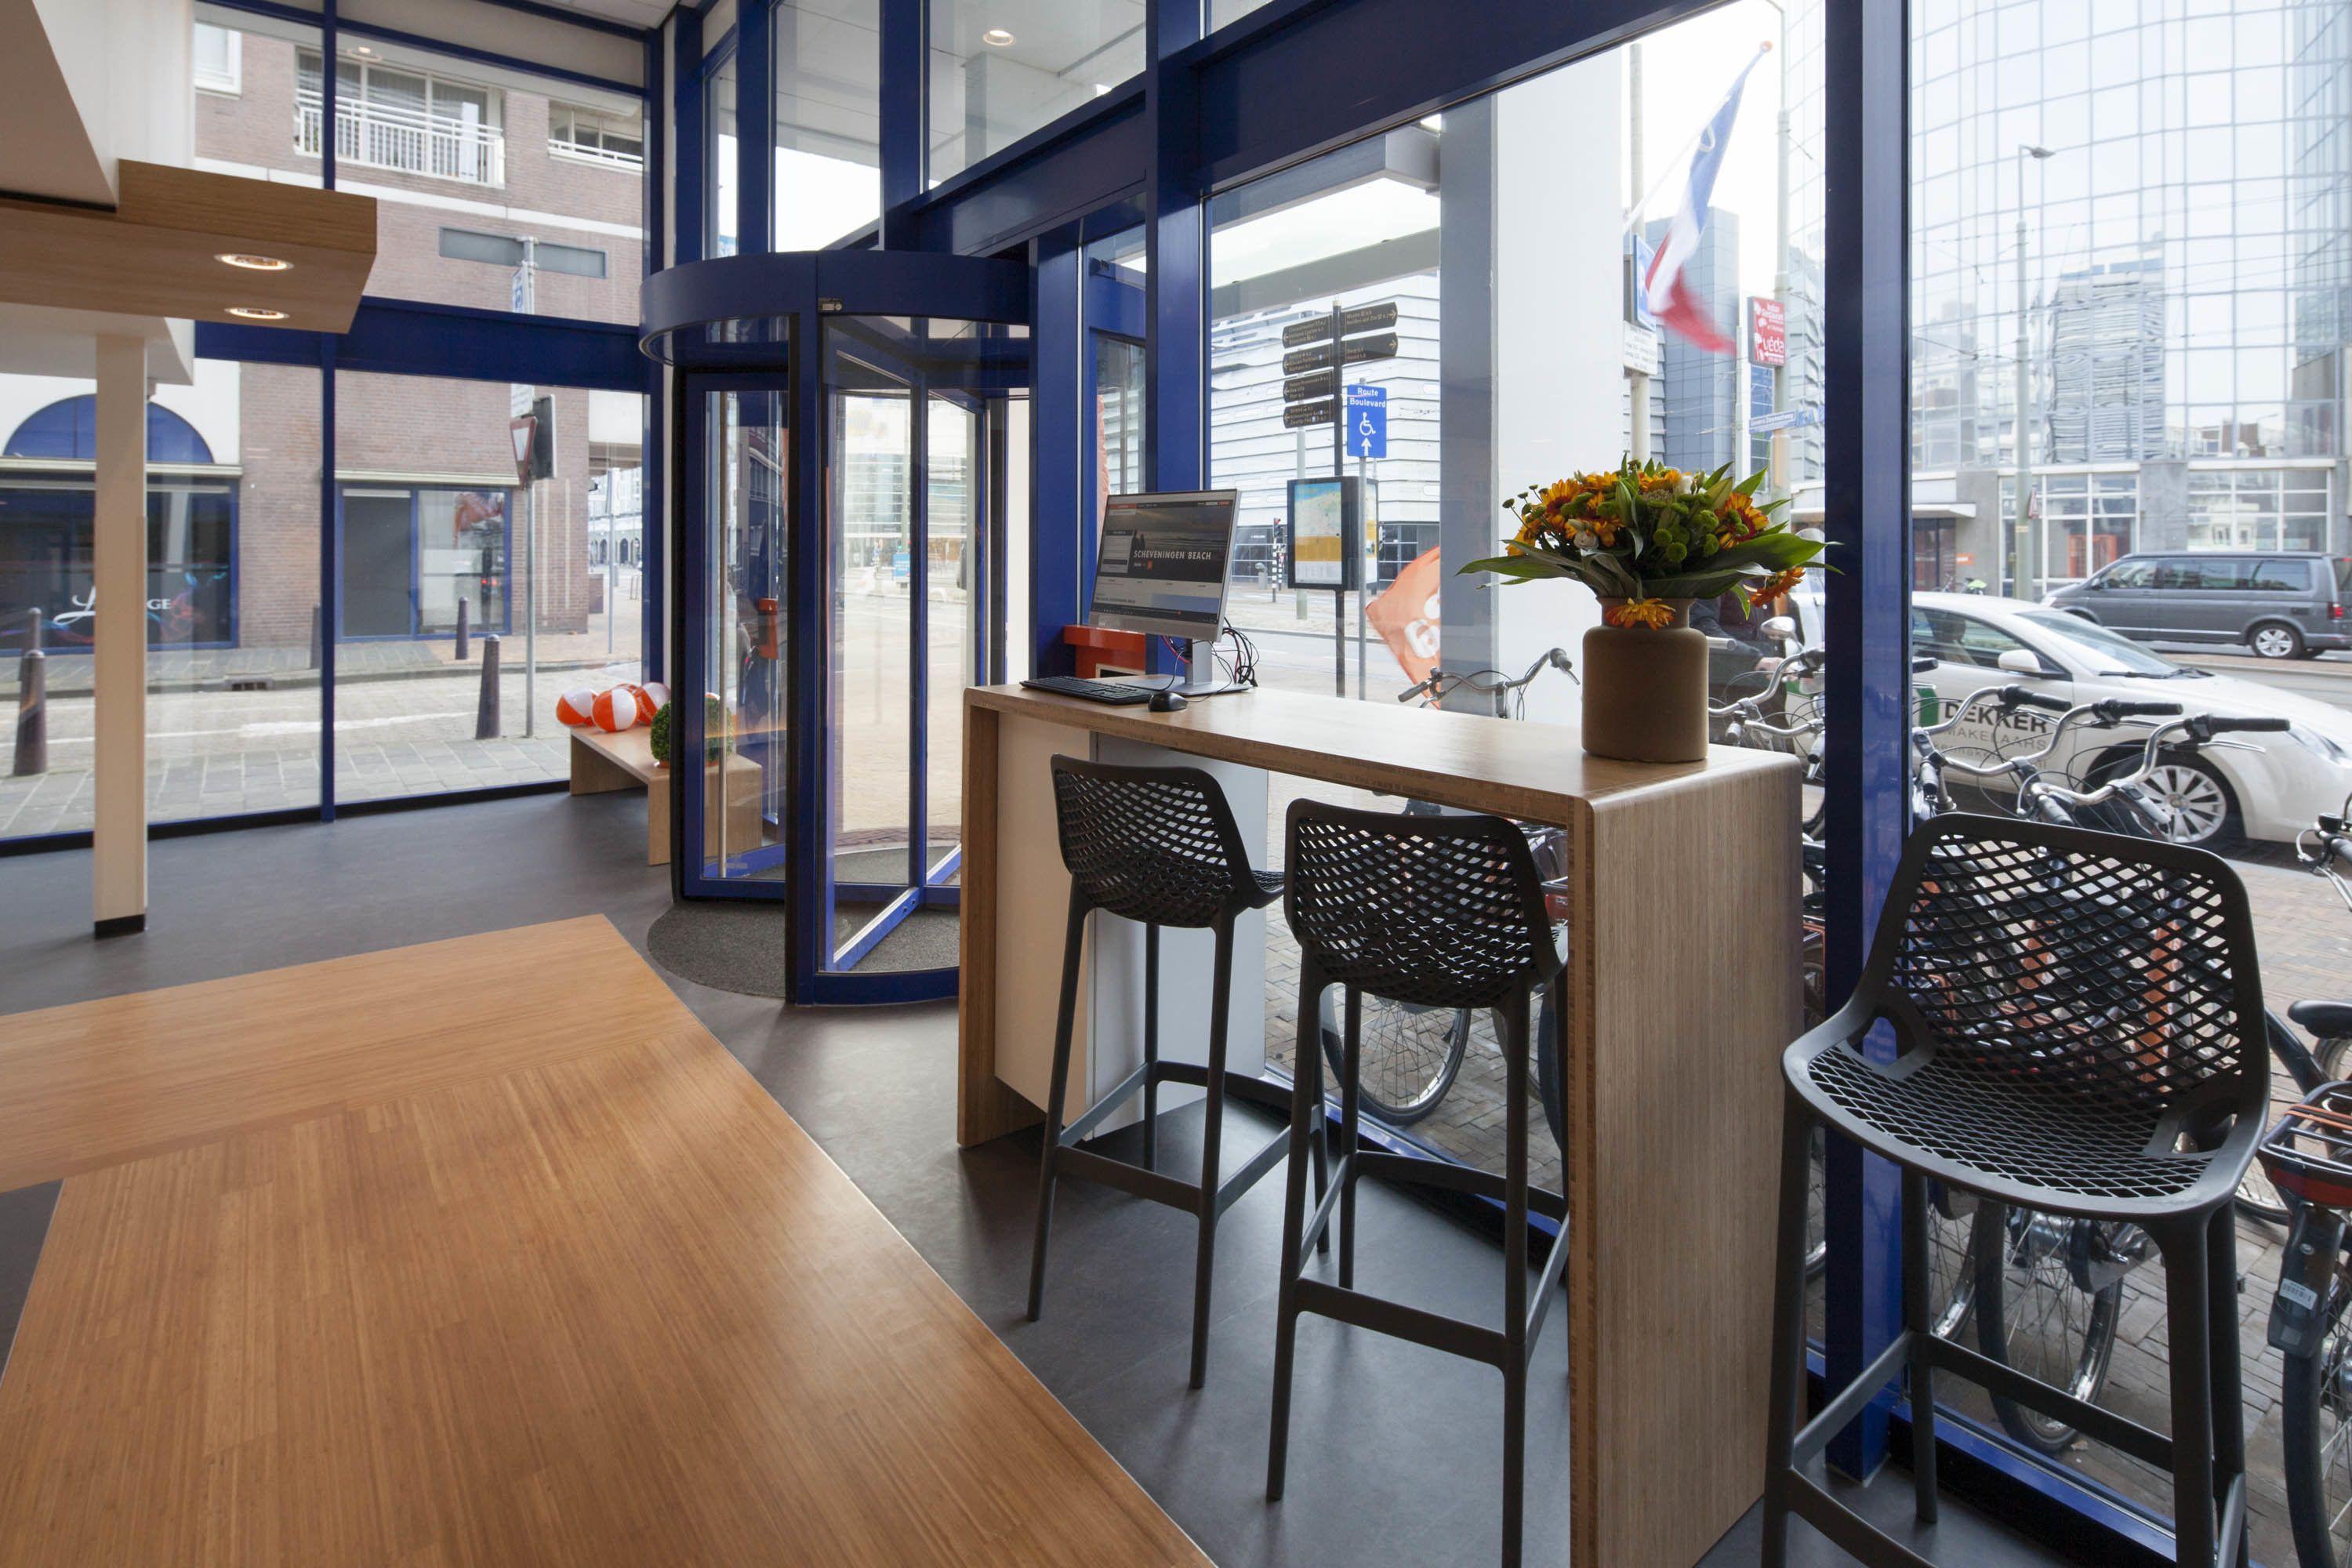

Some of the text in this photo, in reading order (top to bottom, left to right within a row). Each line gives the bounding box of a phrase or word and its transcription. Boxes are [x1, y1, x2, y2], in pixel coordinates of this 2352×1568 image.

[1762, 336, 1784, 354] véda
[1357, 387, 1379, 397] Route
[1349, 397, 1386, 408] Boulevard
[1133, 550, 1211, 561] SCHEVENINGEN BEACH
[1944, 702, 2047, 733] DEKKER
